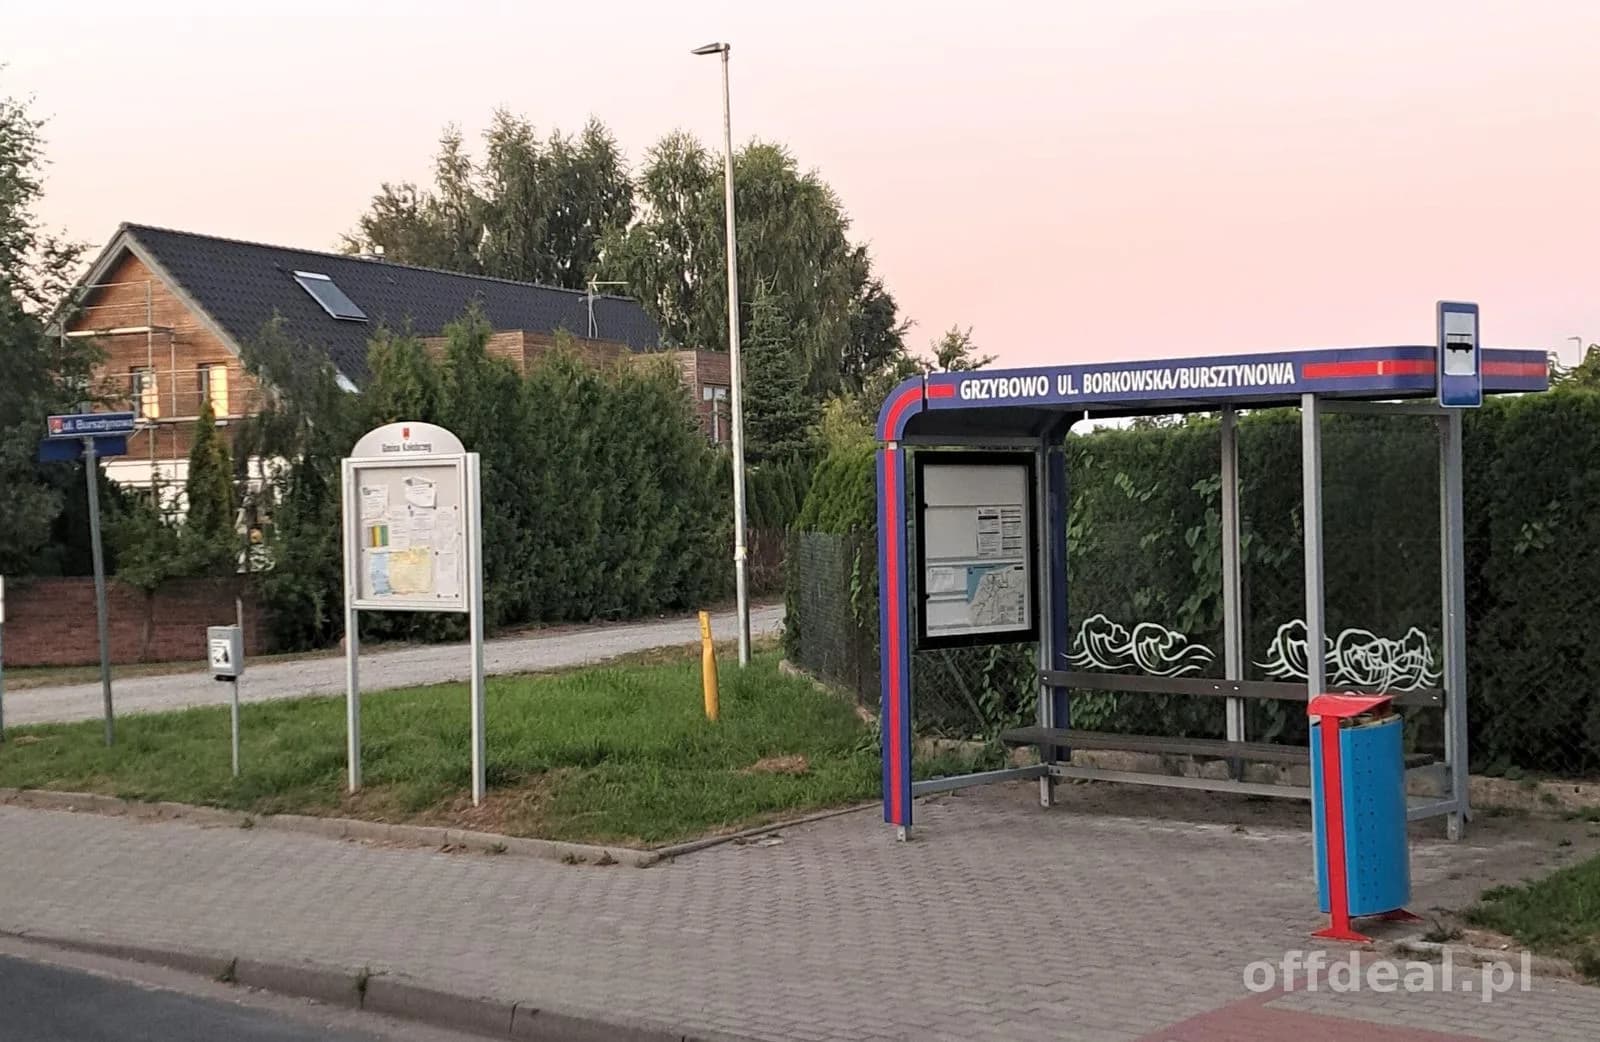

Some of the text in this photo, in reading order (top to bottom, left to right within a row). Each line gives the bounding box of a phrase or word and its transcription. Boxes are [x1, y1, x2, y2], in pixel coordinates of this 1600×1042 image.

[960, 362, 1295, 399] GRZYBOWO UL. BORKOWSKA/BURSZTYNOWA
